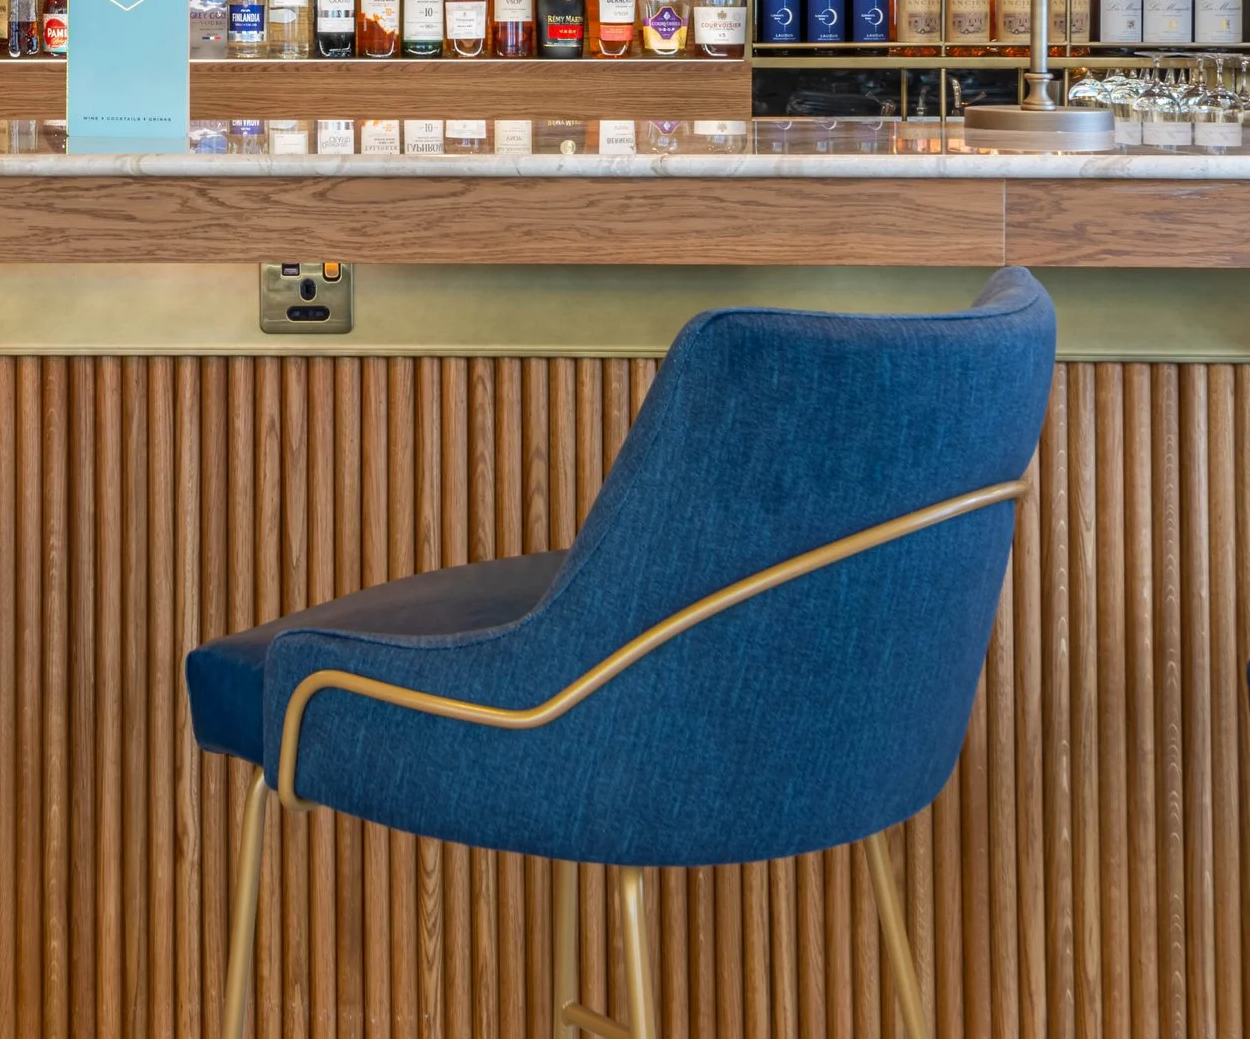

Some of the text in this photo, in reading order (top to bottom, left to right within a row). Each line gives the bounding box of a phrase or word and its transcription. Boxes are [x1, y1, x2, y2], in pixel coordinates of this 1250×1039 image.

[424, 7, 434, 17] 10
[232, 13, 261, 23] FINLANDIA
[548, 15, 565, 23] RÉMY
